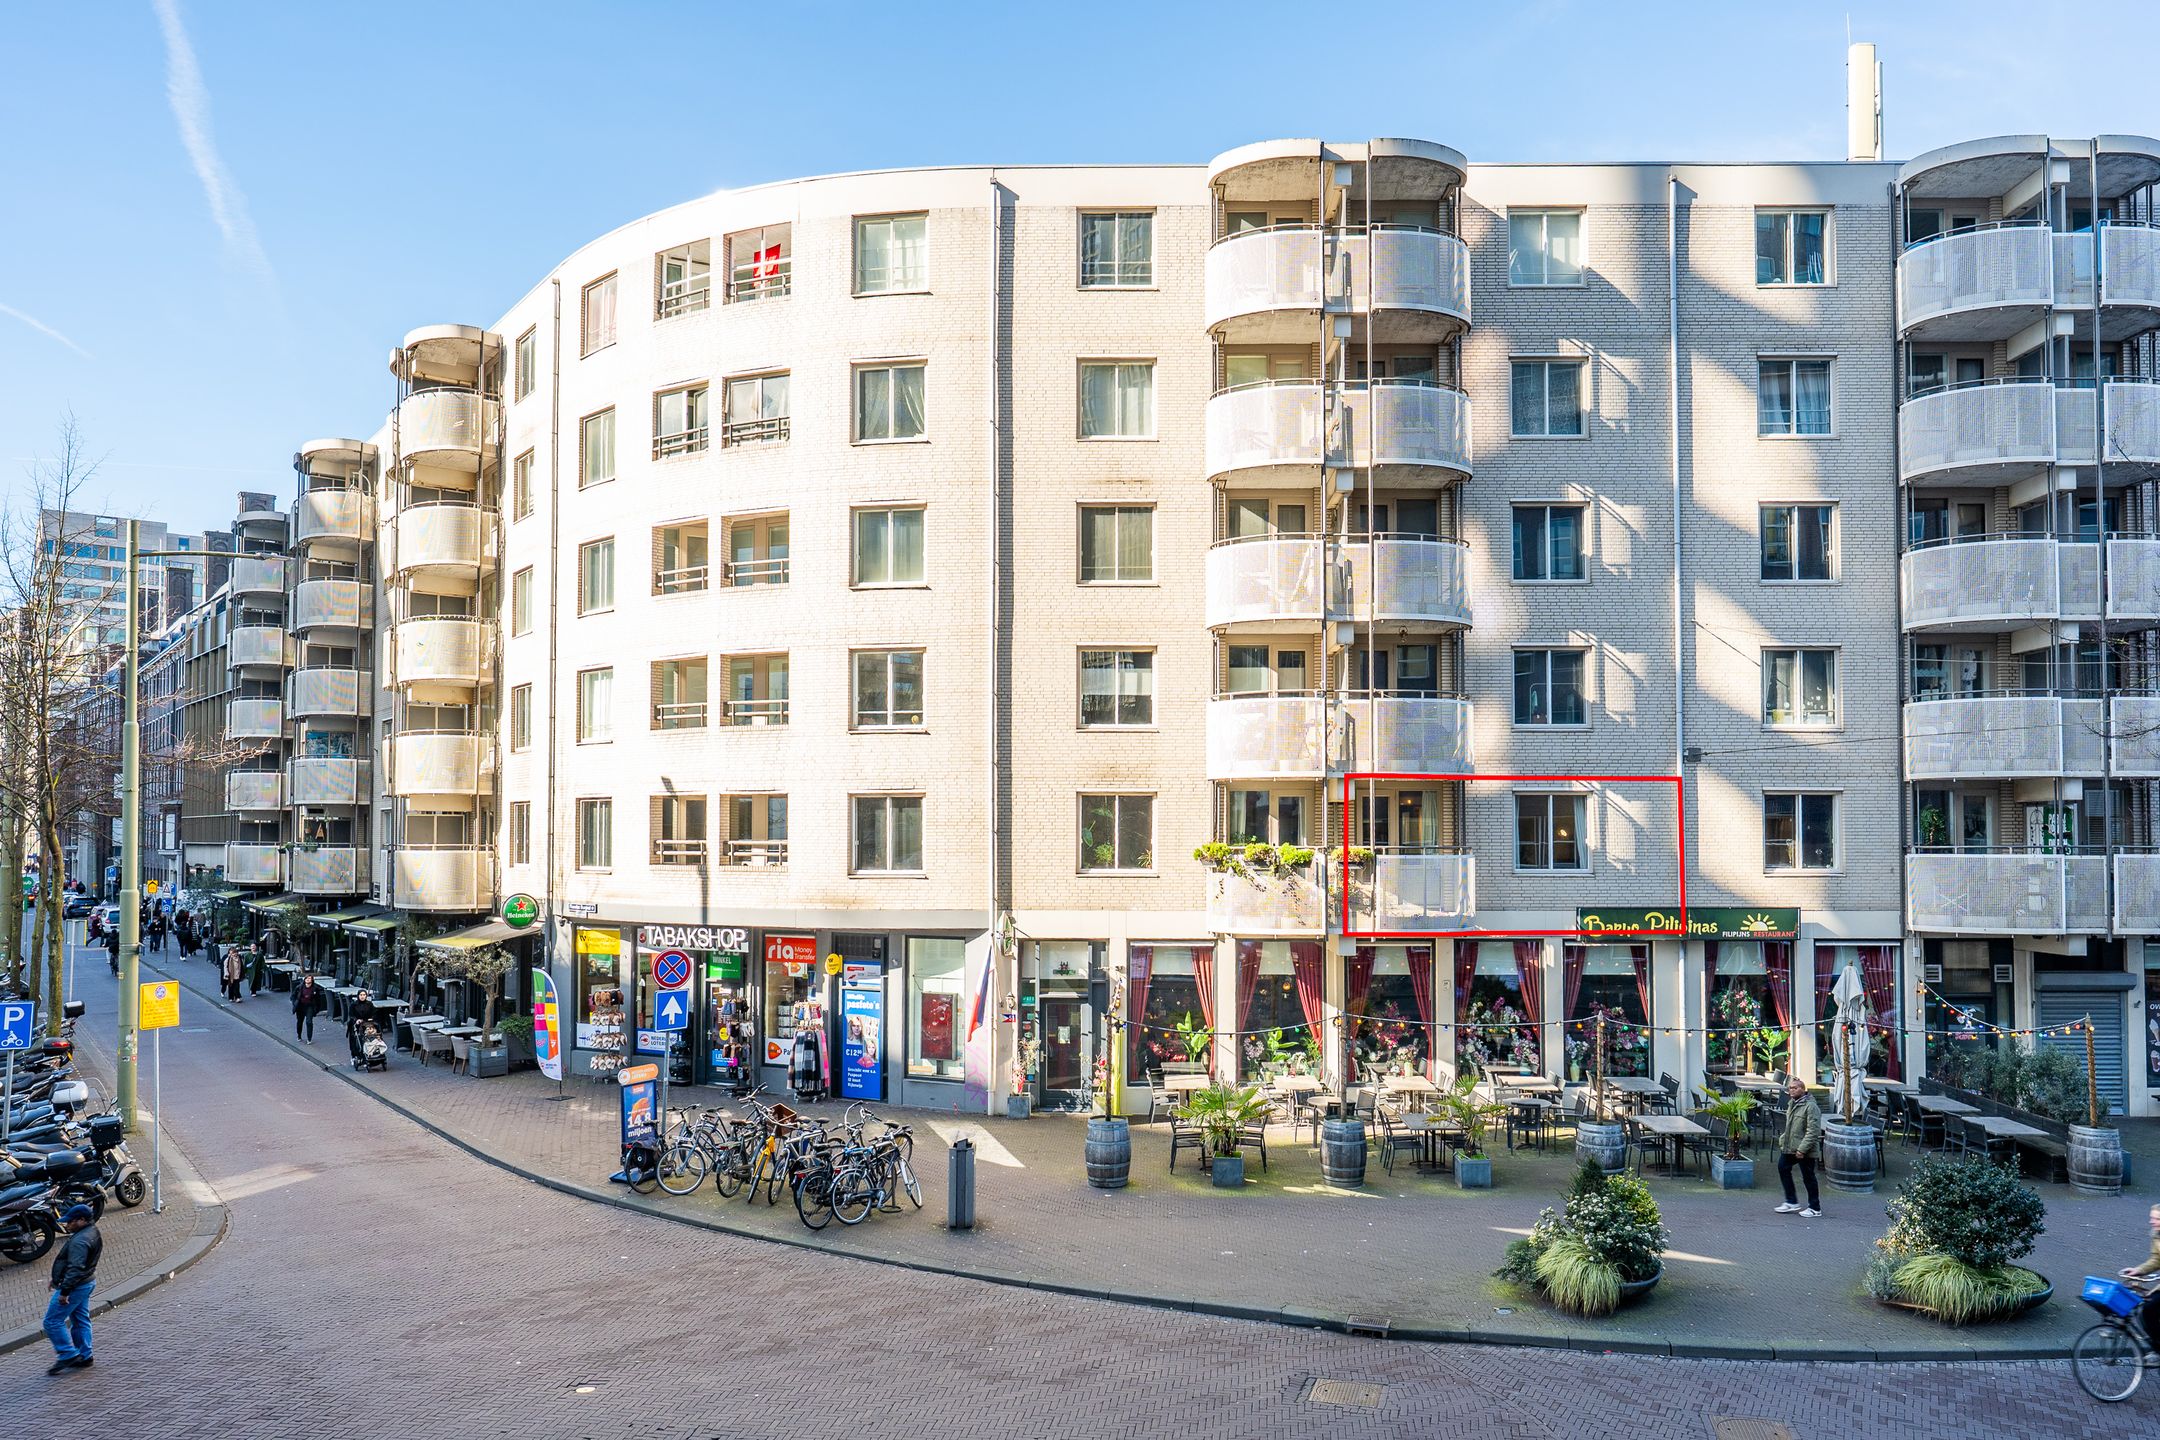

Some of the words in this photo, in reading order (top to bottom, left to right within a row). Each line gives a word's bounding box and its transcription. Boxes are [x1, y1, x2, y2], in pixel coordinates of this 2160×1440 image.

[644, 926, 746, 948] TABAKSHOP
[768, 938, 794, 960] ria
[794, 946, 813, 954] Money
[3, 1006, 25, 1030] P
[627, 1126, 652, 1138] miljoen
